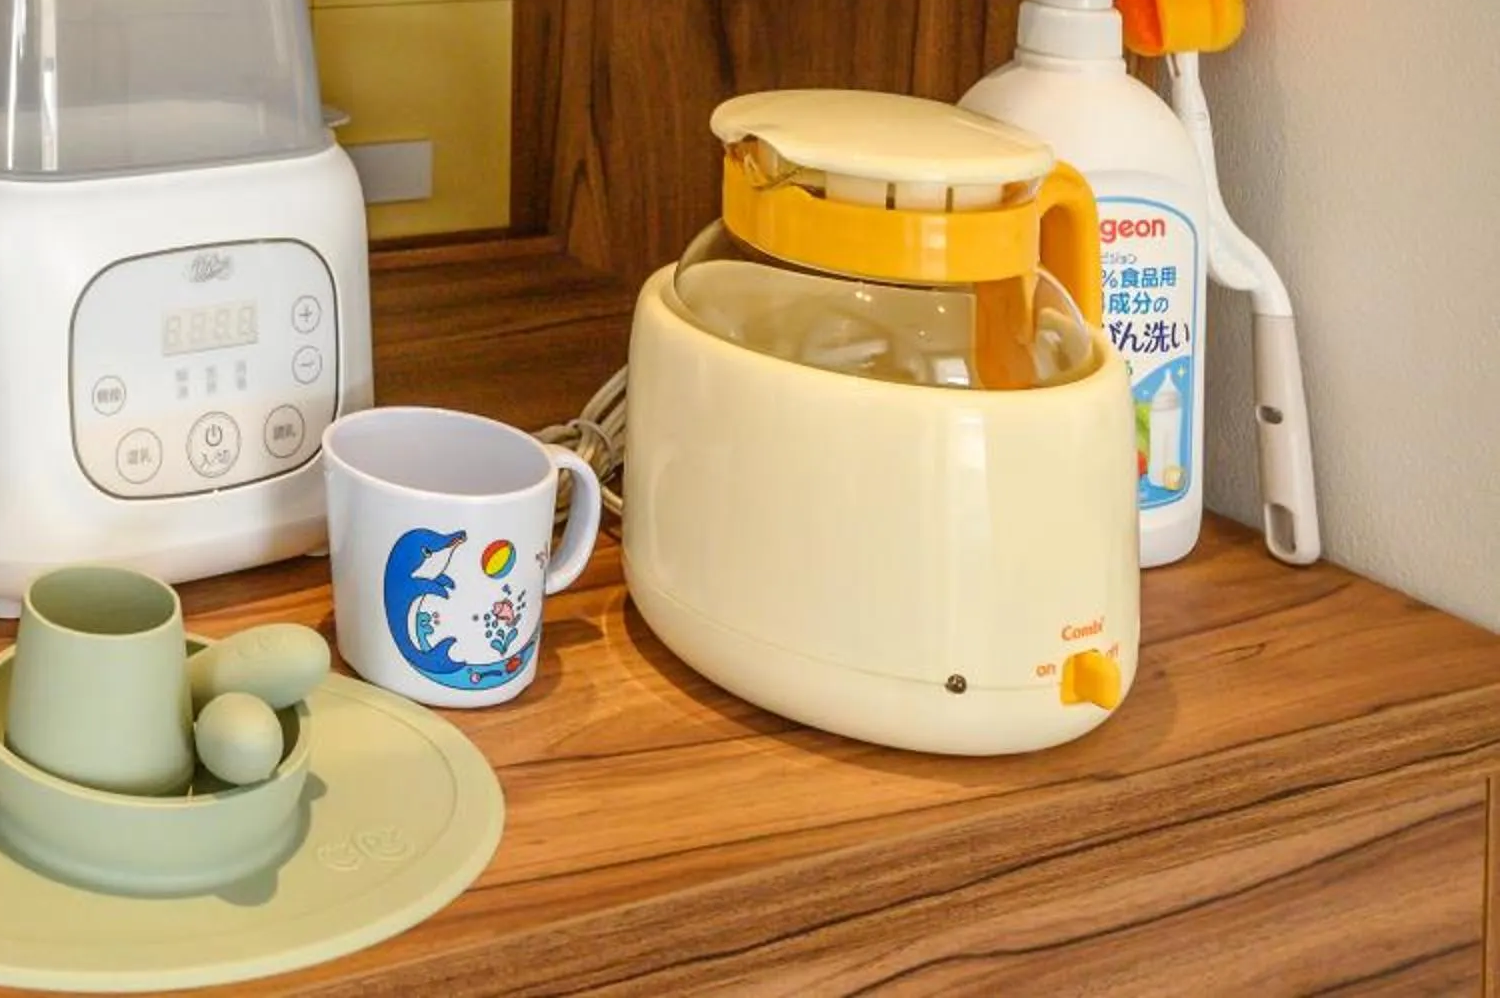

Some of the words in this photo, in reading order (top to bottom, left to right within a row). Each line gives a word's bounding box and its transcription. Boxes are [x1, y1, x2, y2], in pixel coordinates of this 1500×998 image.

[1100, 218, 1165, 244] geon
[1101, 266, 1177, 289] %食品用
[1102, 291, 1169, 315] 成分の
[1101, 319, 1190, 353] びん洗い
[1061, 614, 1105, 641] Combi
[1036, 662, 1057, 678] on
